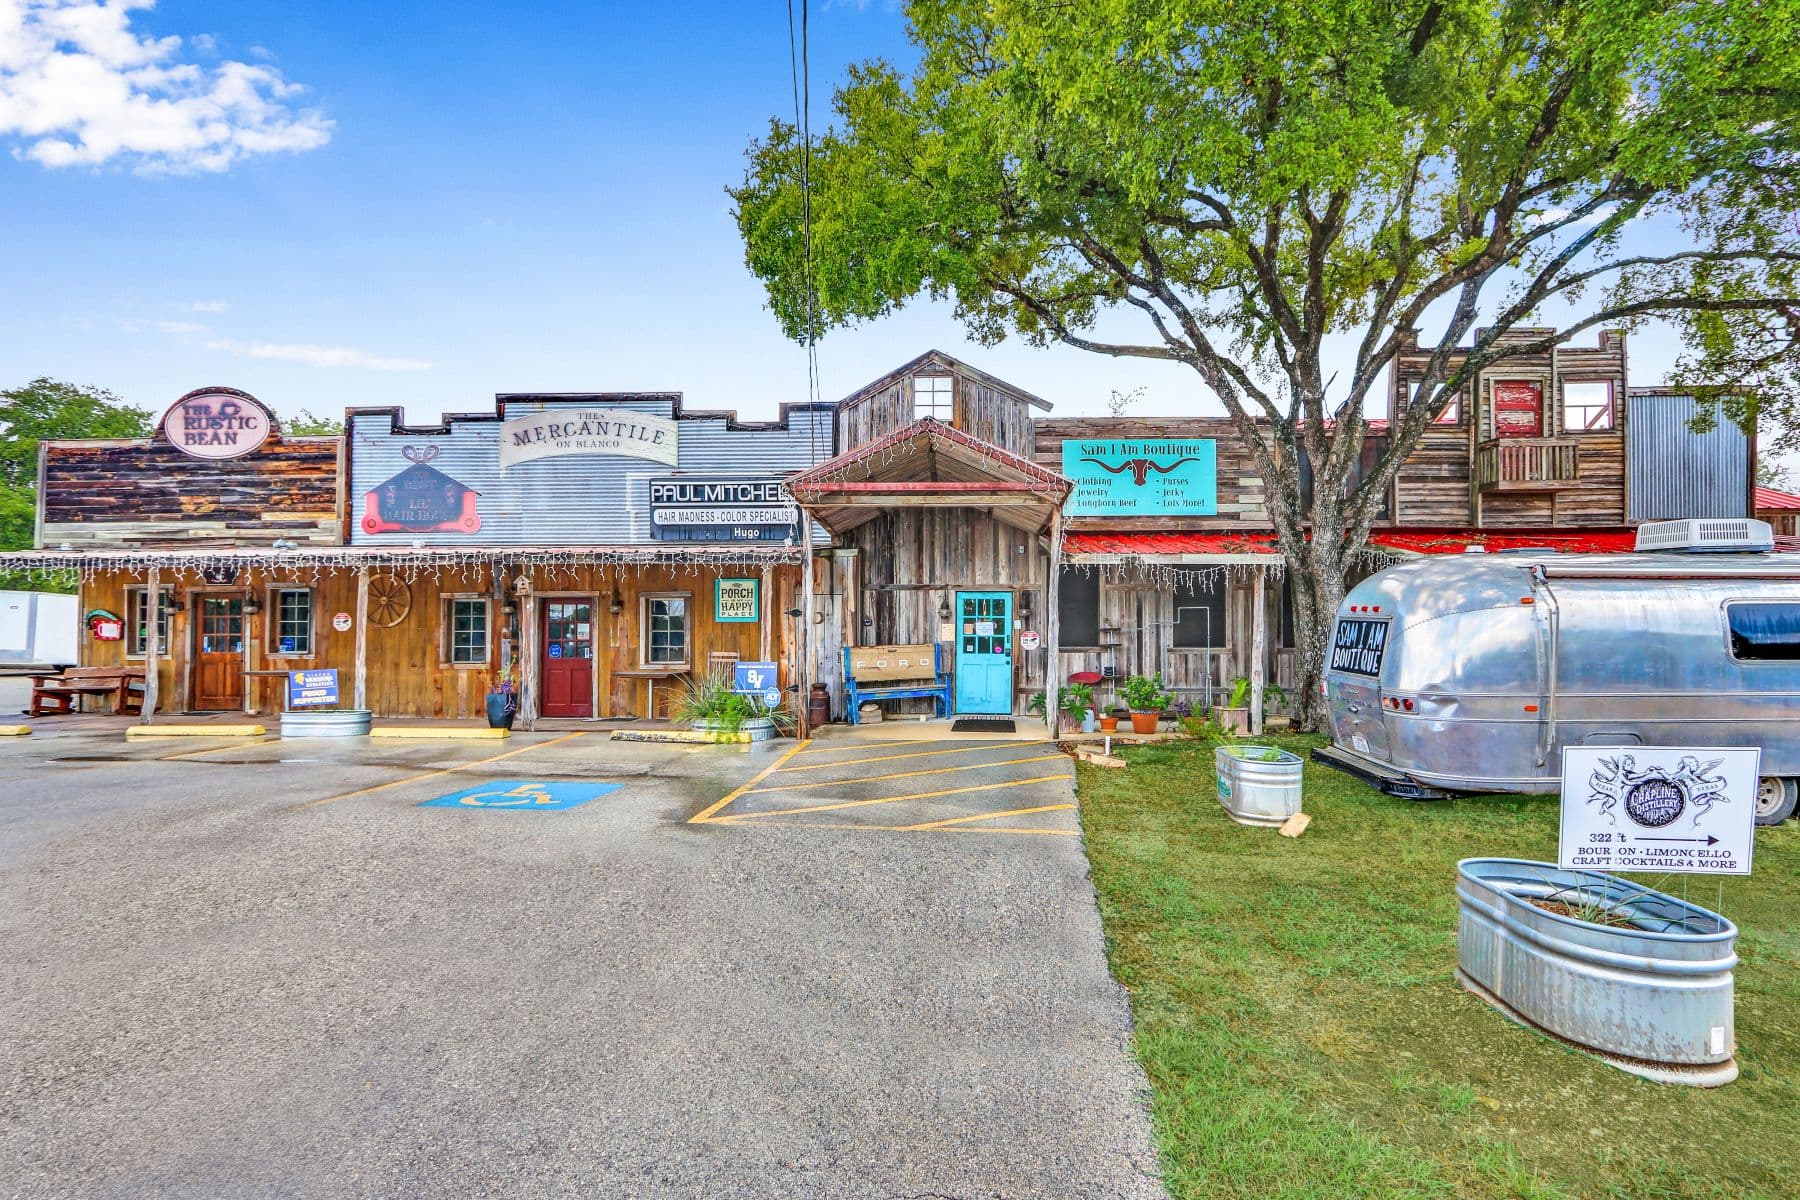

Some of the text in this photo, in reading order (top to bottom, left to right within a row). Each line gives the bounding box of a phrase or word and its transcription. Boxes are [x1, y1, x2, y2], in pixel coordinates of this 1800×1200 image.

[183, 404, 211, 415] THE
[577, 412, 599, 420] THE
[184, 416, 257, 430] RUSTIC
[184, 432, 238, 445] BEAN
[512, 421, 665, 447] MERCANTILE
[556, 440, 620, 448] ON BLANCO
[1081, 443, 1200, 457] Sam I Am Boutique
[1077, 477, 1112, 487] Clothing
[1163, 477, 1189, 486] Purses
[651, 485, 702, 502] PAUL
[1077, 488, 1108, 498] Jewelry
[1163, 488, 1184, 498] Jerky
[658, 511, 676, 521] HAIR
[679, 511, 715, 521] MADNESS
[721, 511, 747, 521] COLOR
[734, 527, 760, 539] Hugo
[721, 588, 753, 599] PORCH
[721, 602, 753, 611] HAPPY
[1338, 622, 1385, 649] SAM I AM
[1333, 648, 1381, 673] BOUTIQUE
[1632, 788, 1678, 806] CHAPLINE
[1636, 799, 1680, 814] DISTILLERY
[1589, 833, 1612, 843] 322
[1578, 847, 1731, 858] BOURON LIMONCELLO
[1572, 857, 1611, 865] CRAFT
[1698, 860, 1737, 869] MORE
